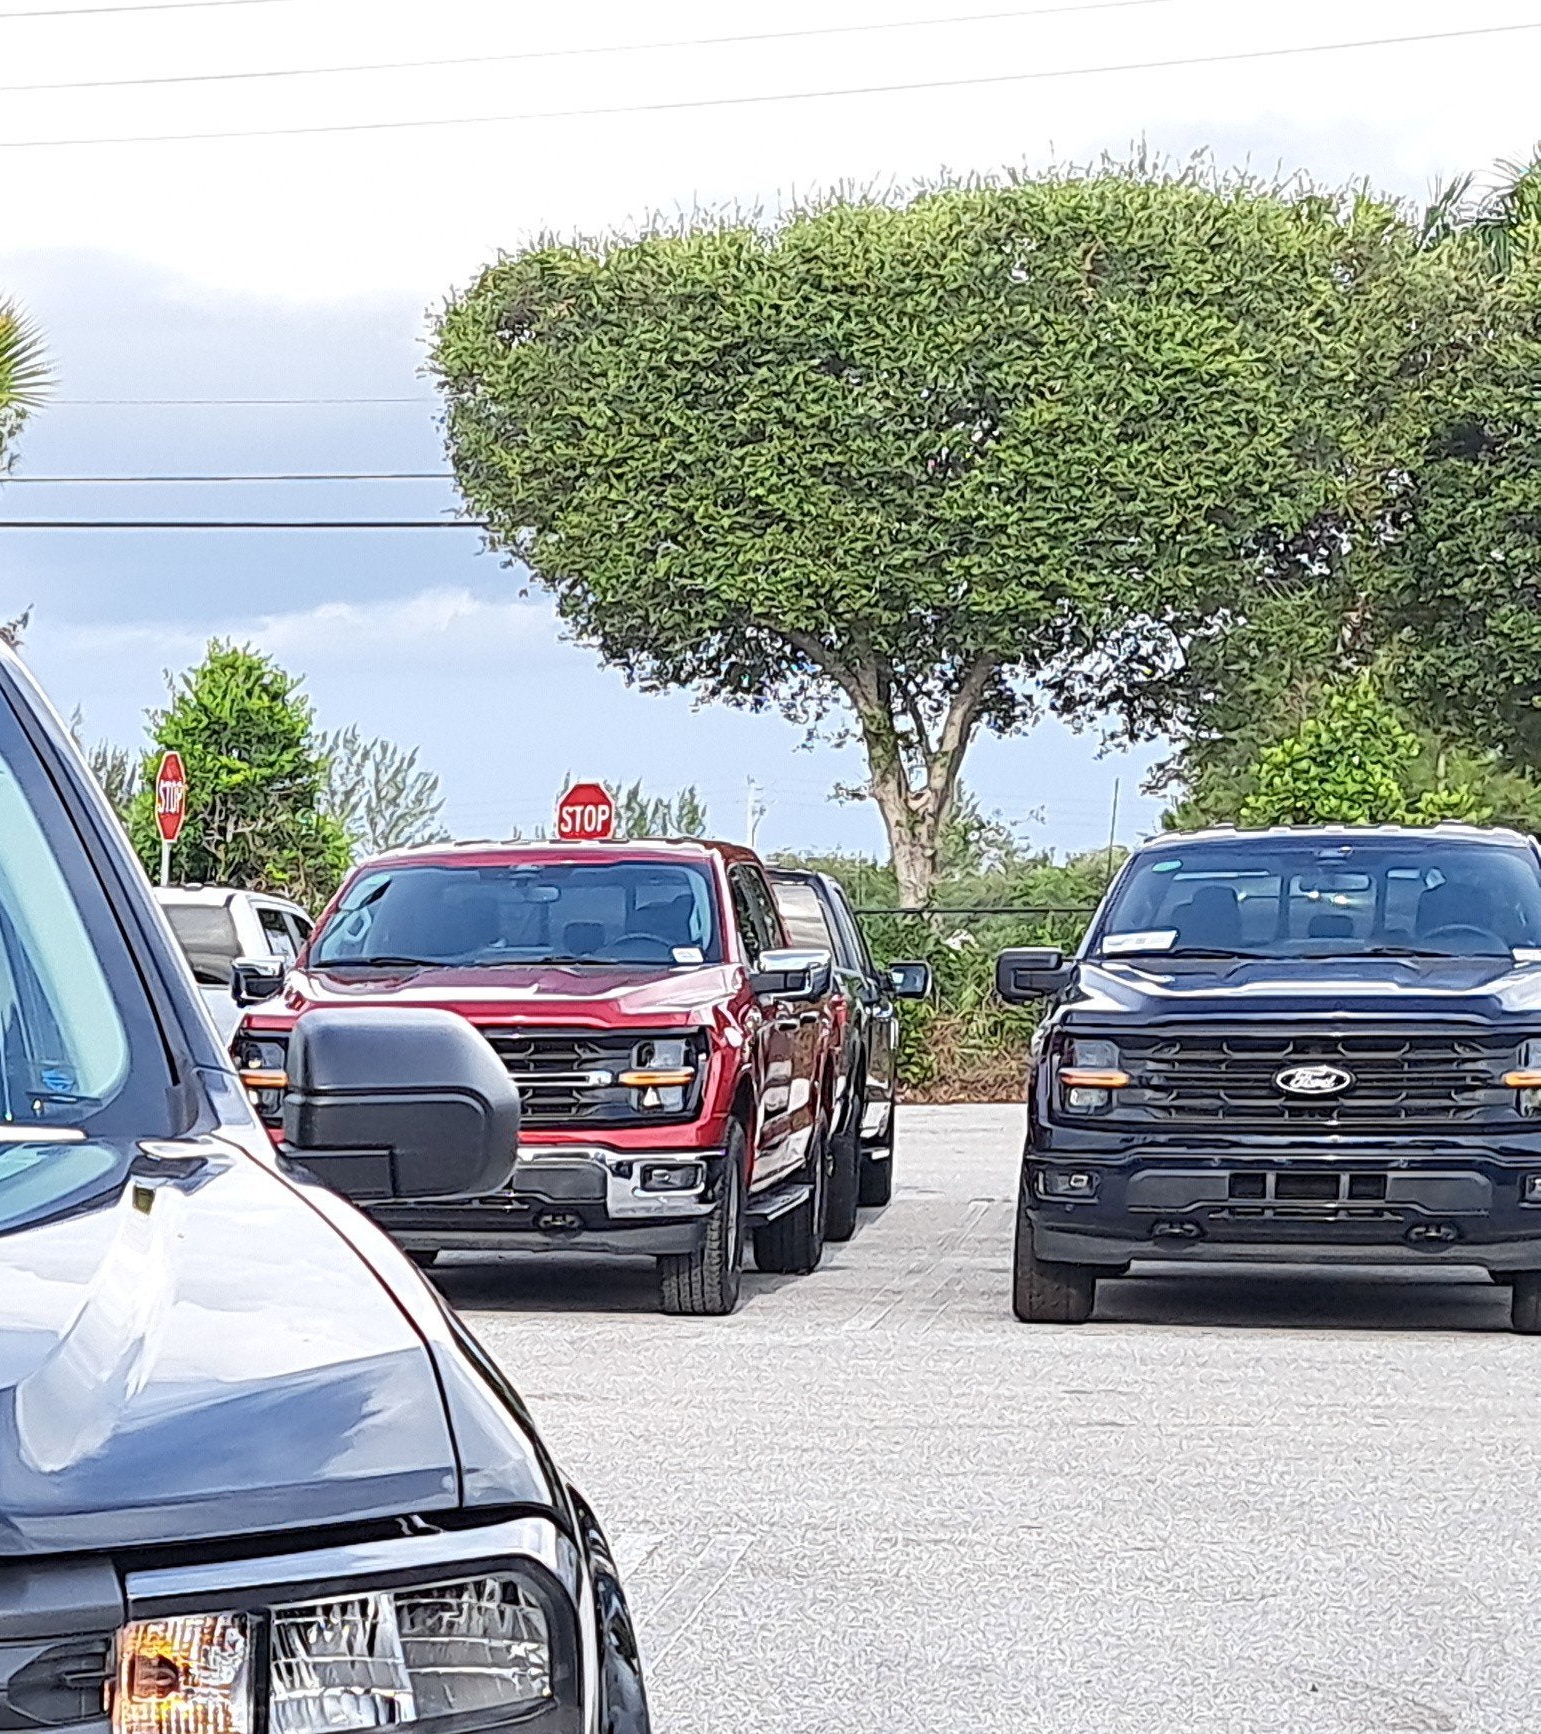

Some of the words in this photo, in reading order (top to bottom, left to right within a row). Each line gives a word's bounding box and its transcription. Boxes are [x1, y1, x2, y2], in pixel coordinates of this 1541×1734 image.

[158, 780, 185, 814] STOP
[560, 804, 610, 833] STOP
[1289, 1068, 1336, 1089] Ford
